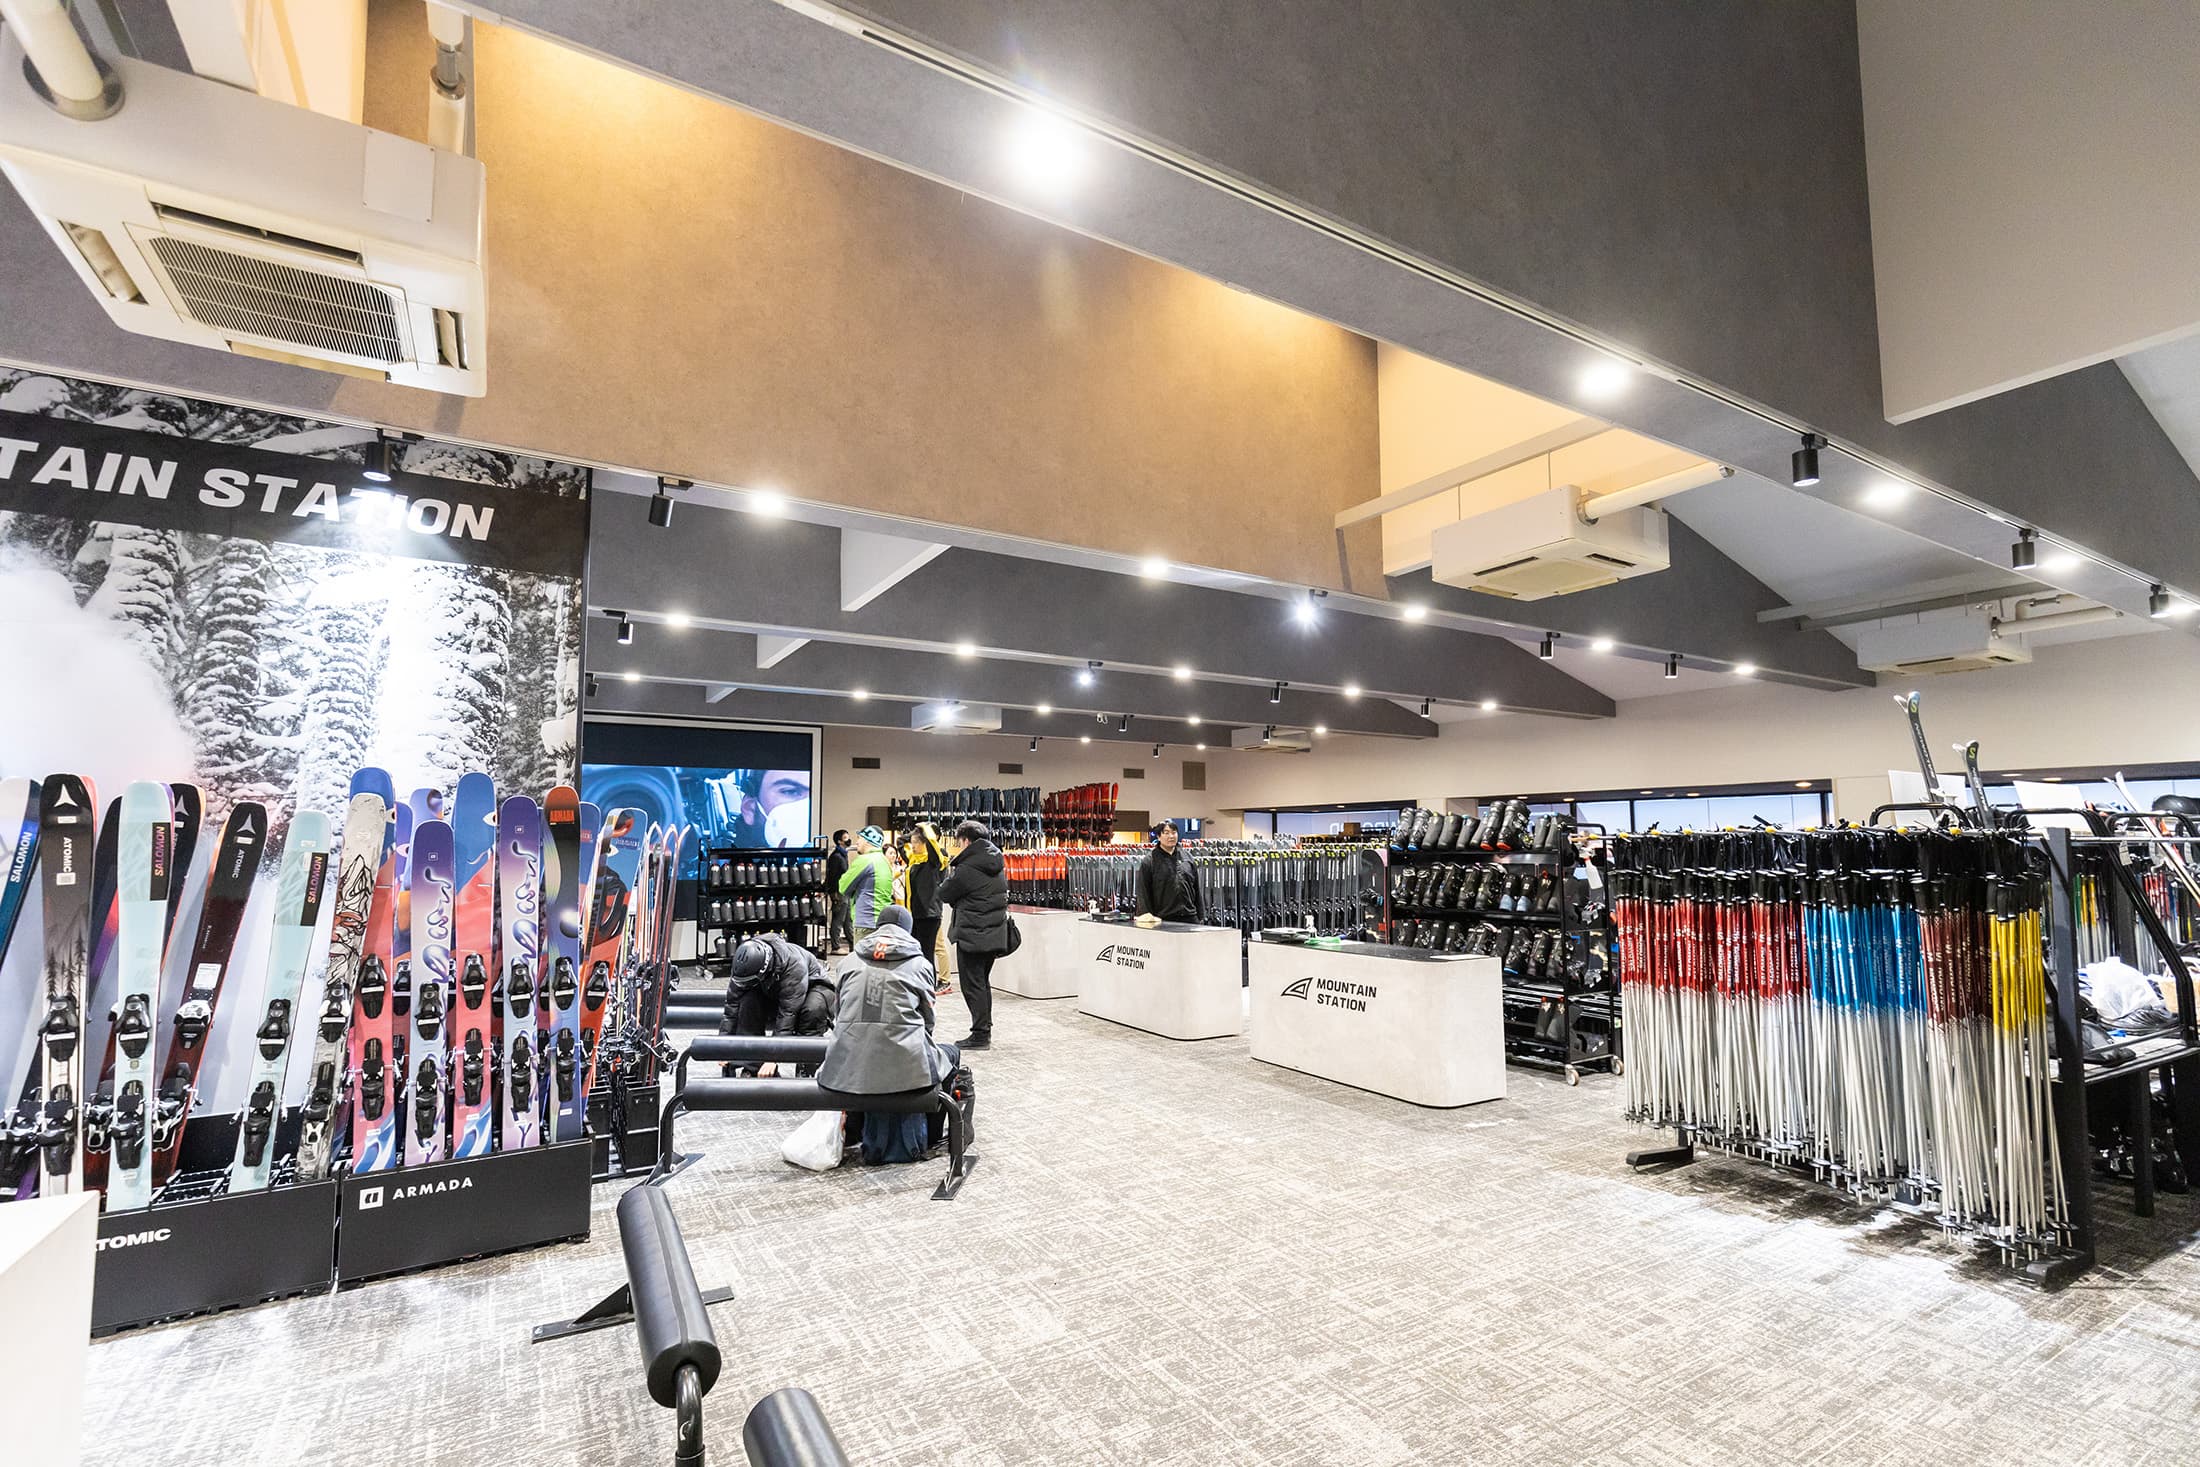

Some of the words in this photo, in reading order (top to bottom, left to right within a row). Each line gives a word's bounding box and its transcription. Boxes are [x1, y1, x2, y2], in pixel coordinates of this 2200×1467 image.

[199, 468, 494, 541] STATION
[10, 831, 32, 883] SALOMON
[63, 836, 72, 873] ATOMIC
[154, 826, 165, 877] SALOMON
[232, 849, 247, 879] ATOMIC
[308, 856, 322, 904] SALOMON
[1116, 945, 1151, 958] MOUNTAIN
[1116, 957, 1145, 970] STATION
[1316, 978, 1377, 998] MOUNTAIN
[1316, 993, 1366, 1012] STATION
[392, 1176, 473, 1199] ARMADA
[96, 1228, 171, 1251] TOMIC
